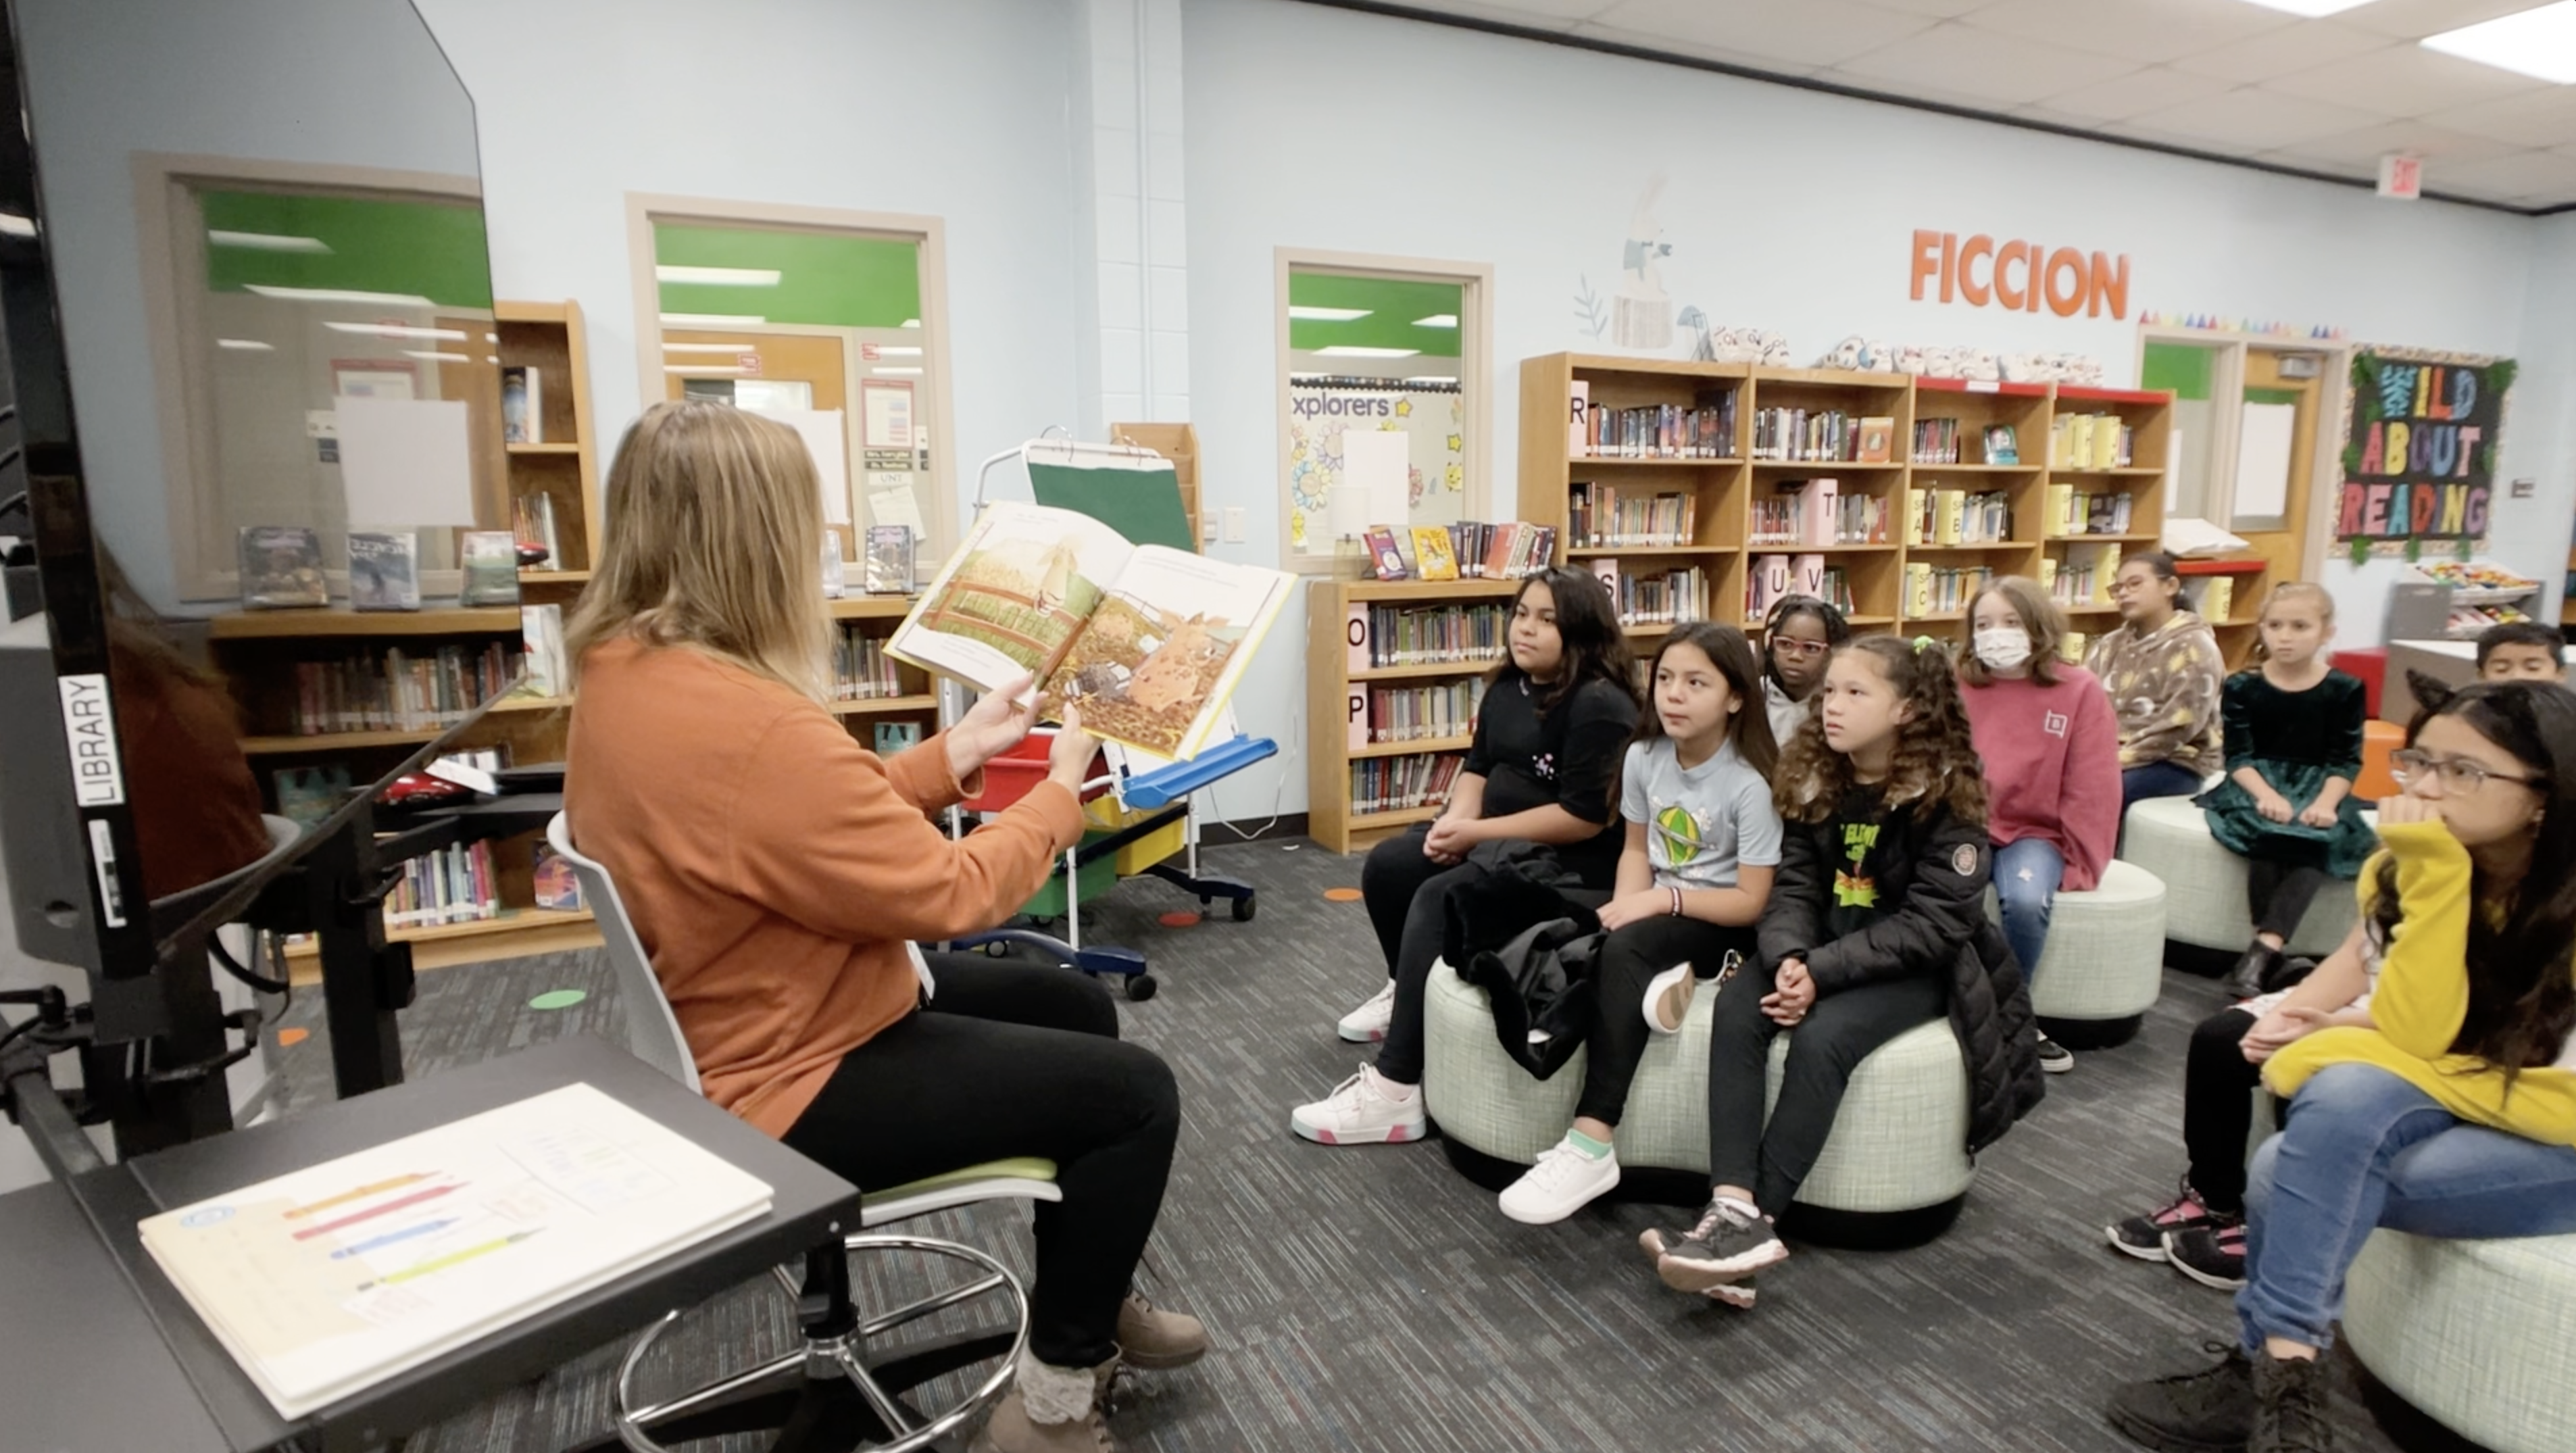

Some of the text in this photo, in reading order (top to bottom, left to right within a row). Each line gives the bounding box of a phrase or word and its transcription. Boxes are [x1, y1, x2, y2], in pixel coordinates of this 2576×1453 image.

[1910, 228, 2130, 320] FICCION
[1291, 392, 1389, 420] xplorers
[2382, 366, 2477, 421] WILD
[1570, 397, 1585, 424] R
[2363, 424, 2481, 478] ABOUT
[1823, 493, 1835, 517] T
[2339, 483, 2489, 536] READING
[1913, 518, 1923, 533] A
[1953, 518, 1961, 533] B
[1599, 573, 1614, 601] S
[1773, 568, 1785, 594] U
[1808, 568, 1821, 592] V
[1918, 590, 1927, 606] C
[1347, 618, 1366, 647] O
[1348, 695, 1364, 724] P
[69, 680, 116, 803] LIBRARY
